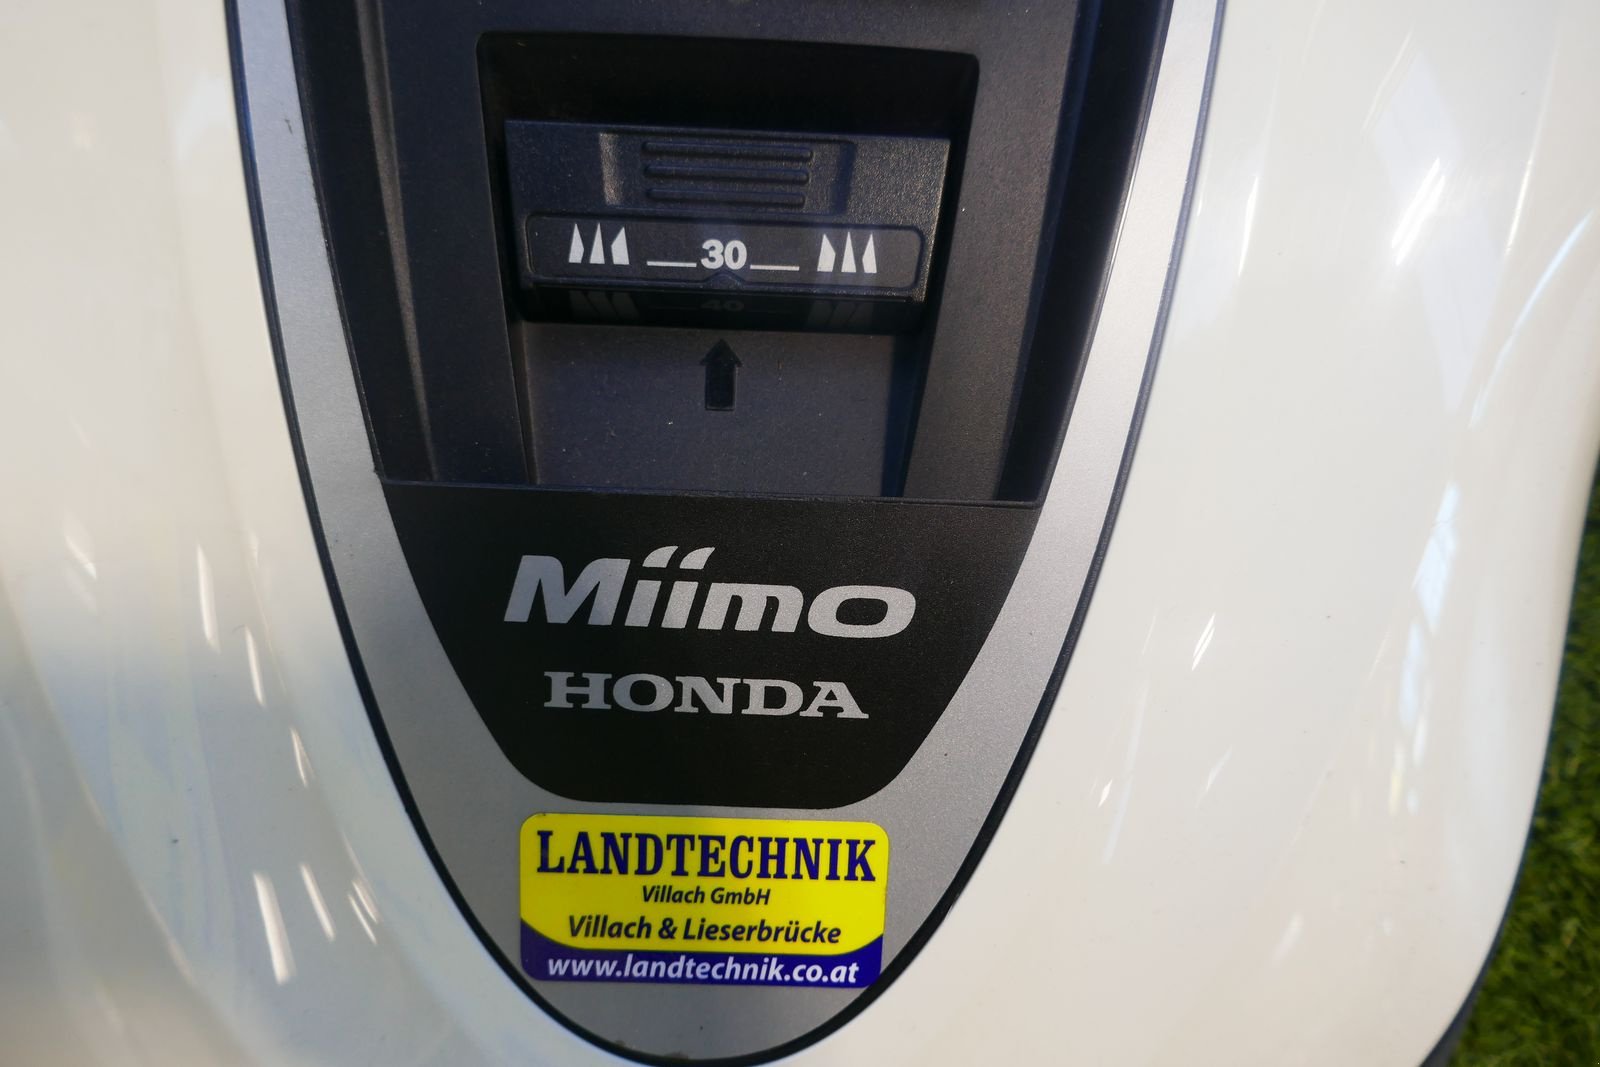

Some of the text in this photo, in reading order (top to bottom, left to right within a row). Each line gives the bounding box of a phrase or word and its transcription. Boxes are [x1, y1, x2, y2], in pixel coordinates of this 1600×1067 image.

[701, 239, 747, 271] 30
[503, 545, 917, 639] Miimo
[543, 671, 870, 719] HONDA
[536, 829, 876, 882] LANDTECHNIK
[642, 884, 771, 906] Villach GmbH
[568, 914, 842, 944] Villach & Lieserbrücke
[547, 952, 860, 984] www.landtechnik.co.at
